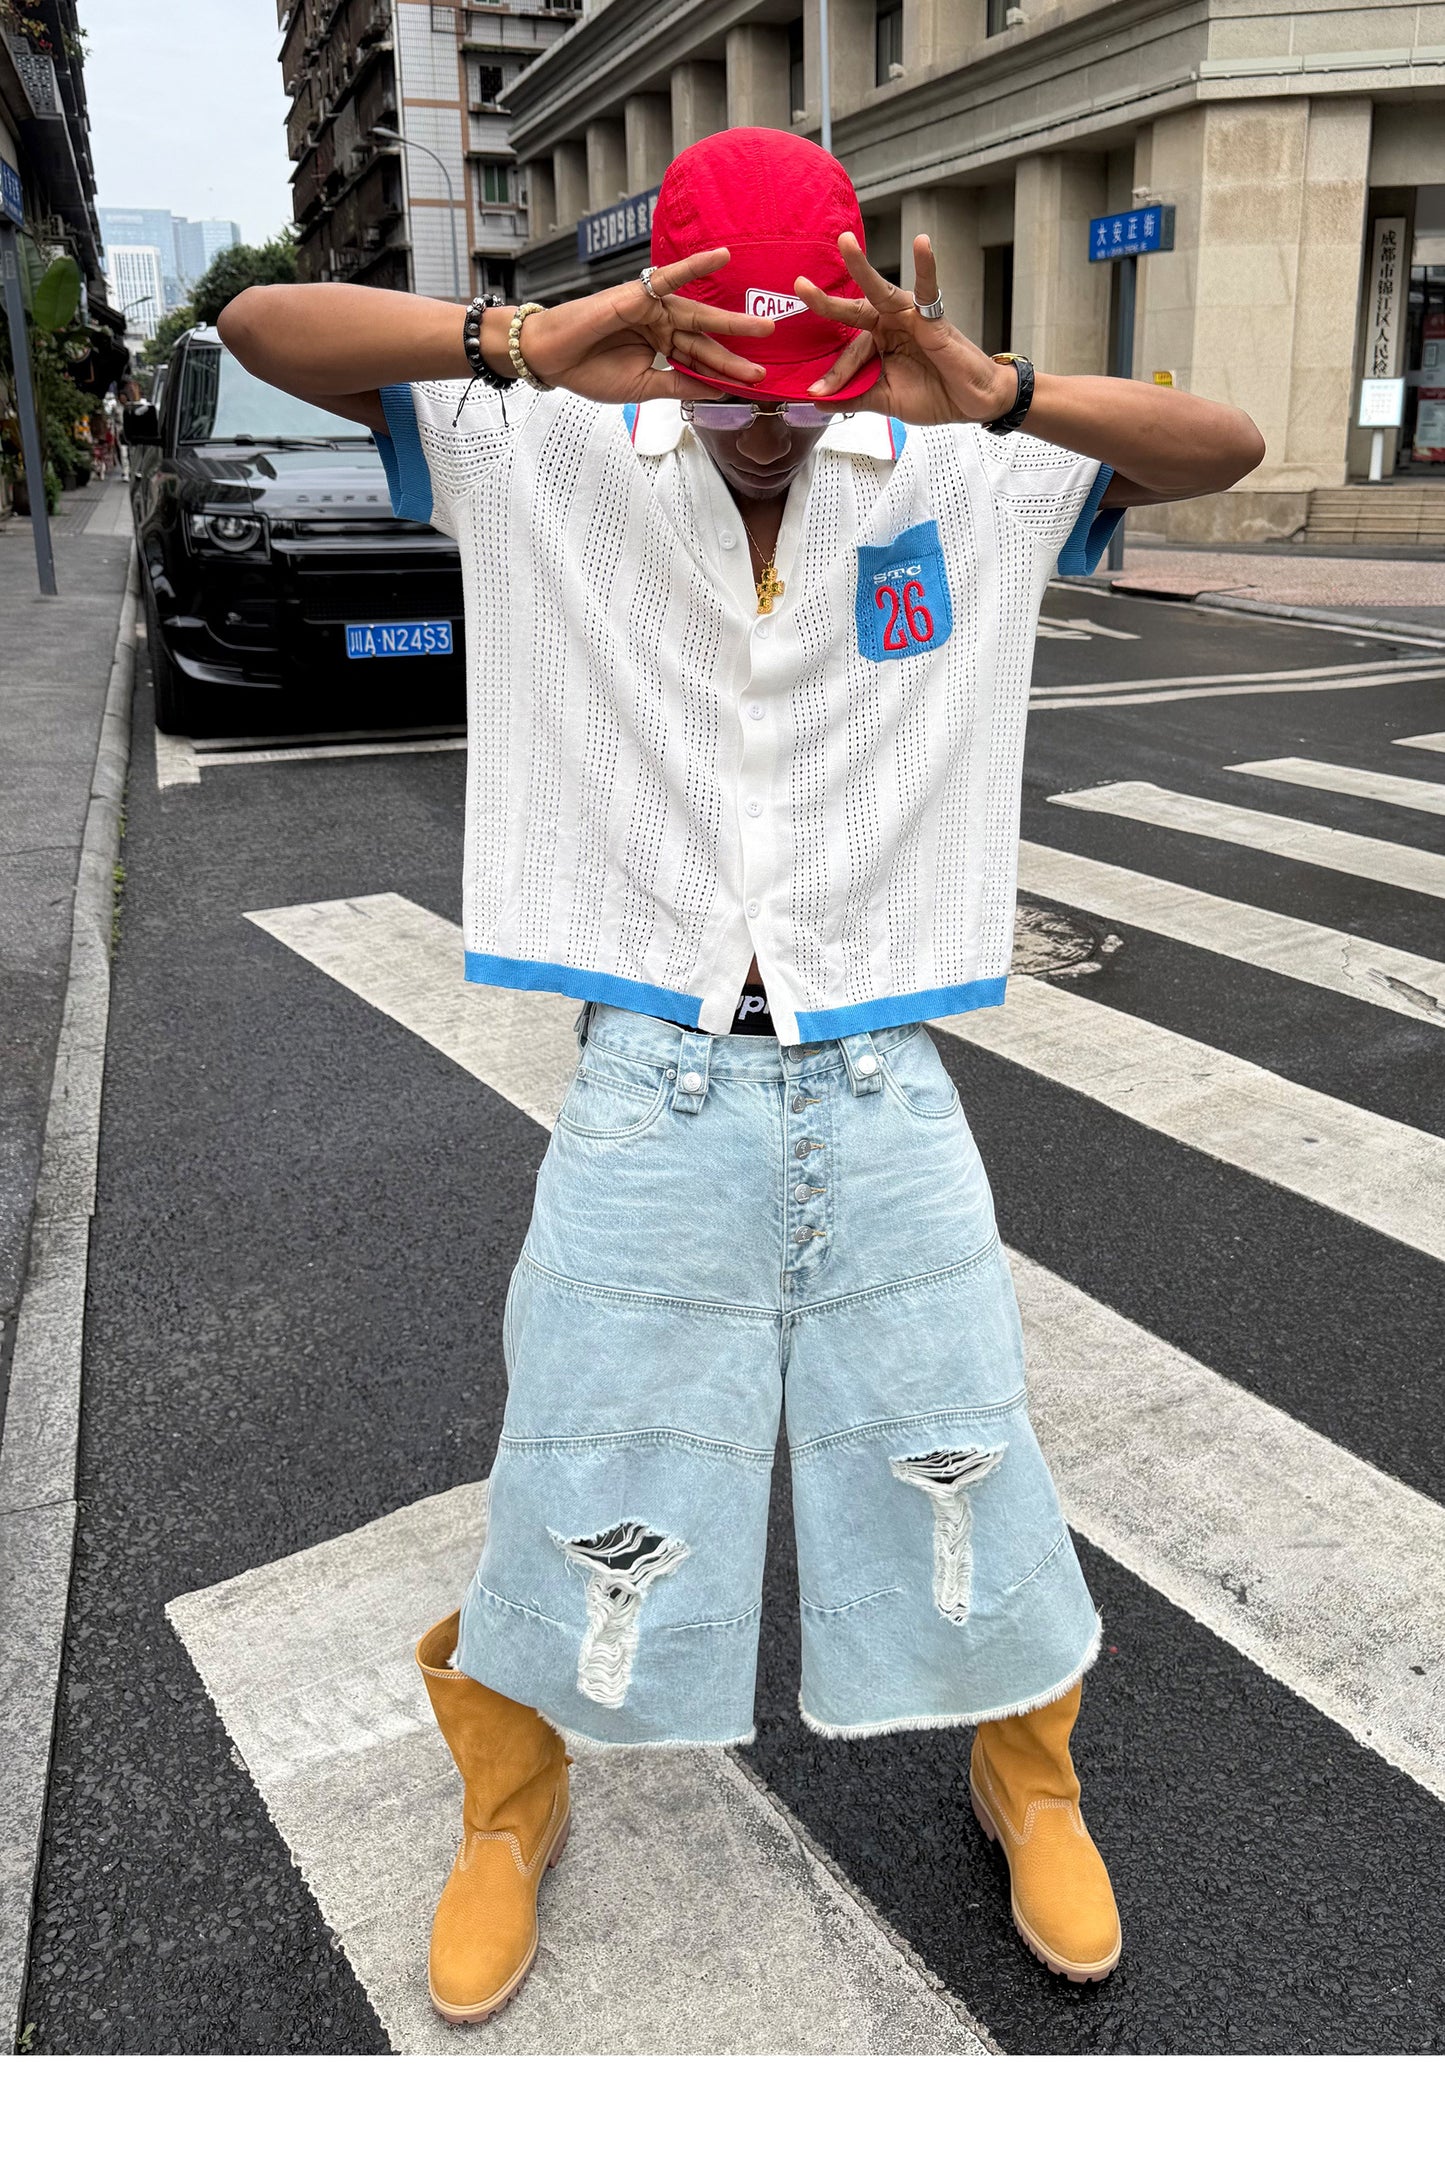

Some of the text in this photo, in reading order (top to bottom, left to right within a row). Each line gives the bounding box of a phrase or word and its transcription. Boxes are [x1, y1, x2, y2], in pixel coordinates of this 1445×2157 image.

[1096, 213, 1155, 247] 大安正街
[753, 295, 794, 317] CALM
[1372, 229, 1397, 378] 成都市锦江区人民检
[873, 564, 922, 584] STC
[875, 580, 934, 651] 26
